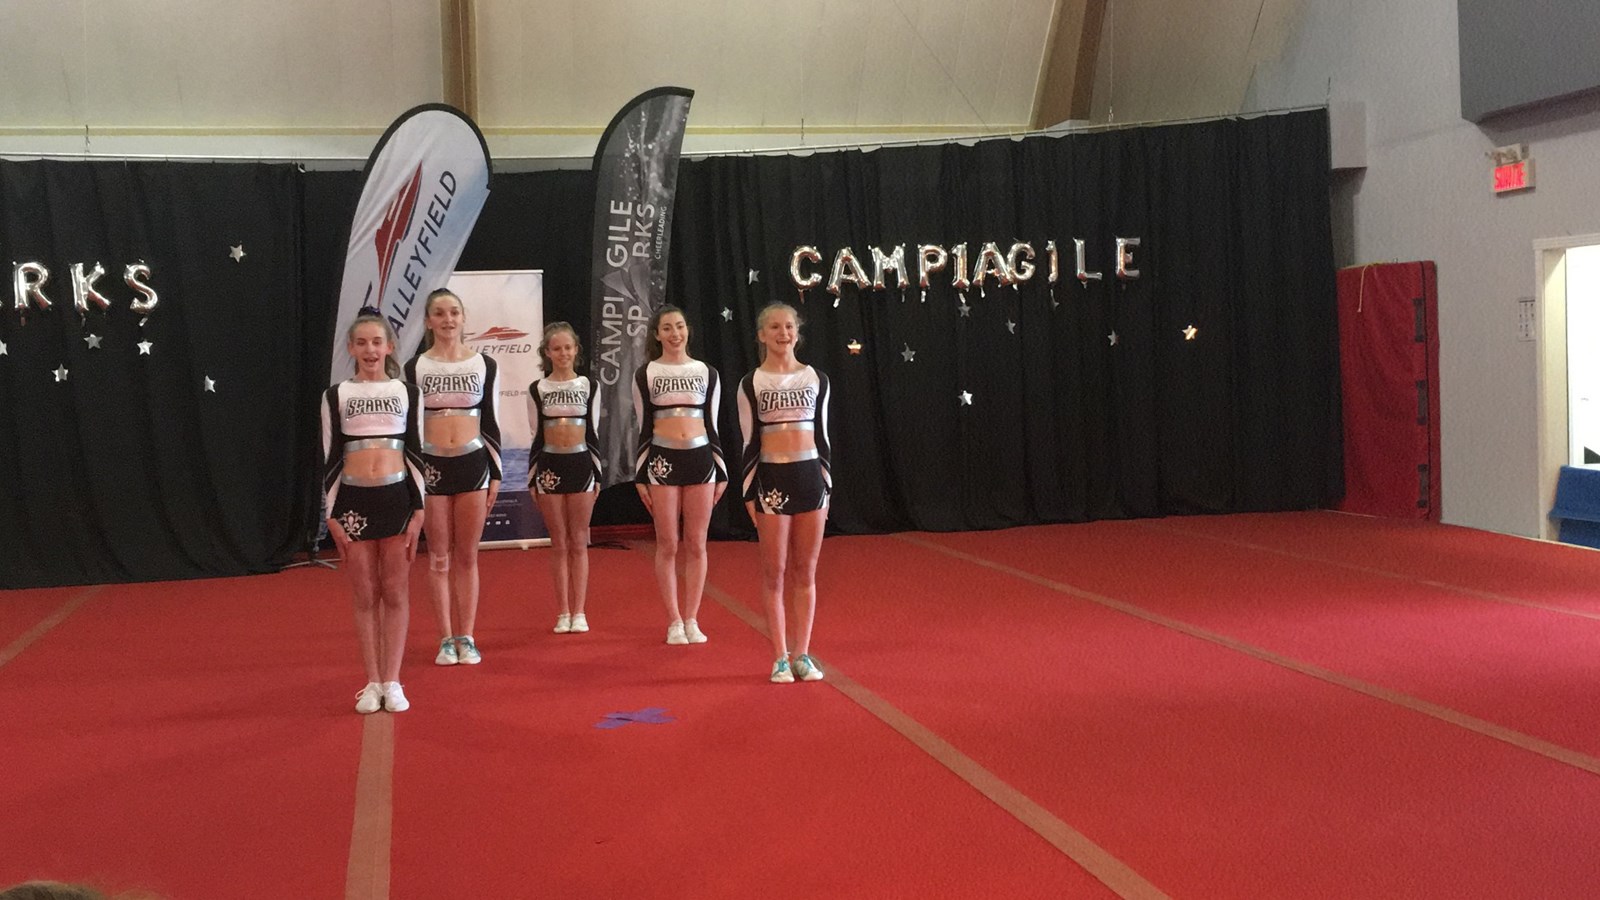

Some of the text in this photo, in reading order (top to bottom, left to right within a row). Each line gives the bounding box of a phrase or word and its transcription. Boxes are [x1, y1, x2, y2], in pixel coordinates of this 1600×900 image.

[655, 206, 667, 260] CHEERLEADING
[386, 170, 457, 339] ALLEYFIELD
[13, 260, 158, 314] RKS
[470, 344, 532, 354] LEYFIELD
[423, 374, 480, 394] SPARKS
[654, 378, 705, 395] SPARKS
[347, 398, 401, 416] SPARKS
[761, 388, 815, 411] SPARKS
